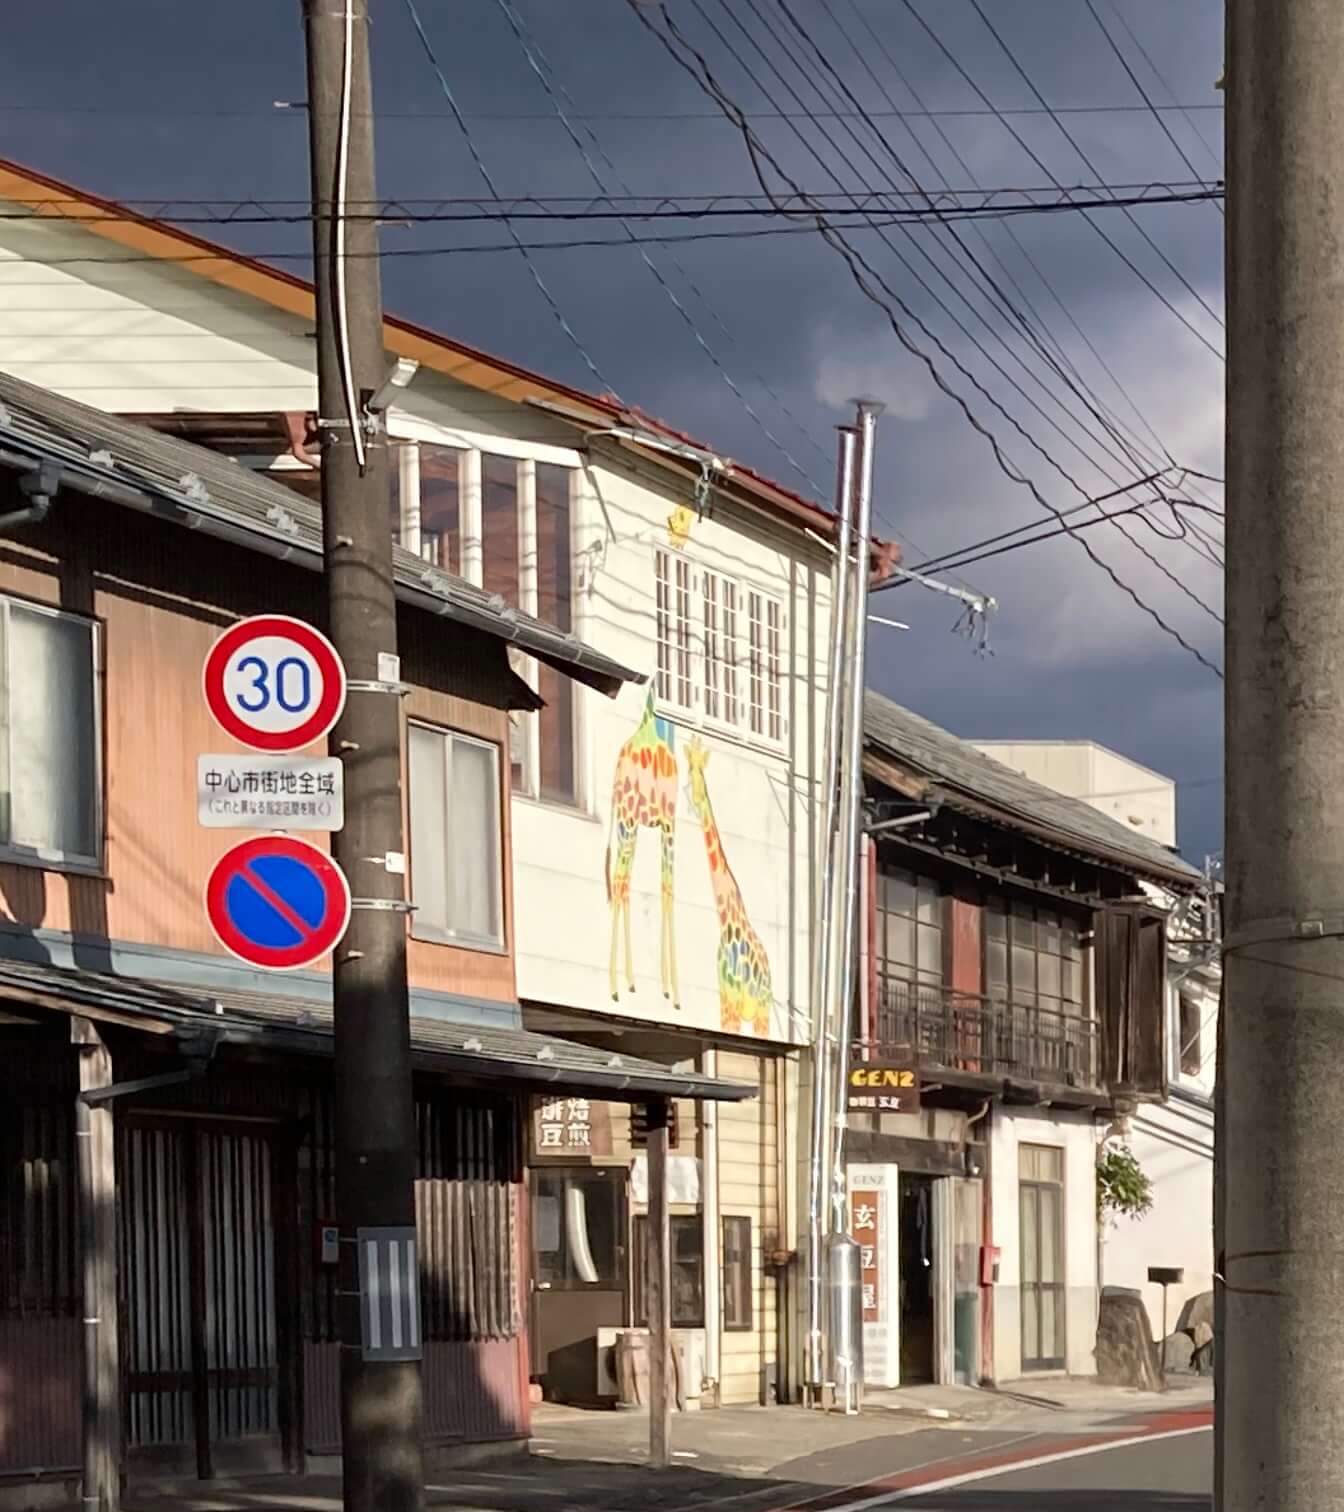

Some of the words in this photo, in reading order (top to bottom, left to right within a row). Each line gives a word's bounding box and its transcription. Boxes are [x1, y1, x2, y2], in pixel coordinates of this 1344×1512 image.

[236, 656, 311, 713] 30
[205, 768, 334, 795] 中心市街地全域
